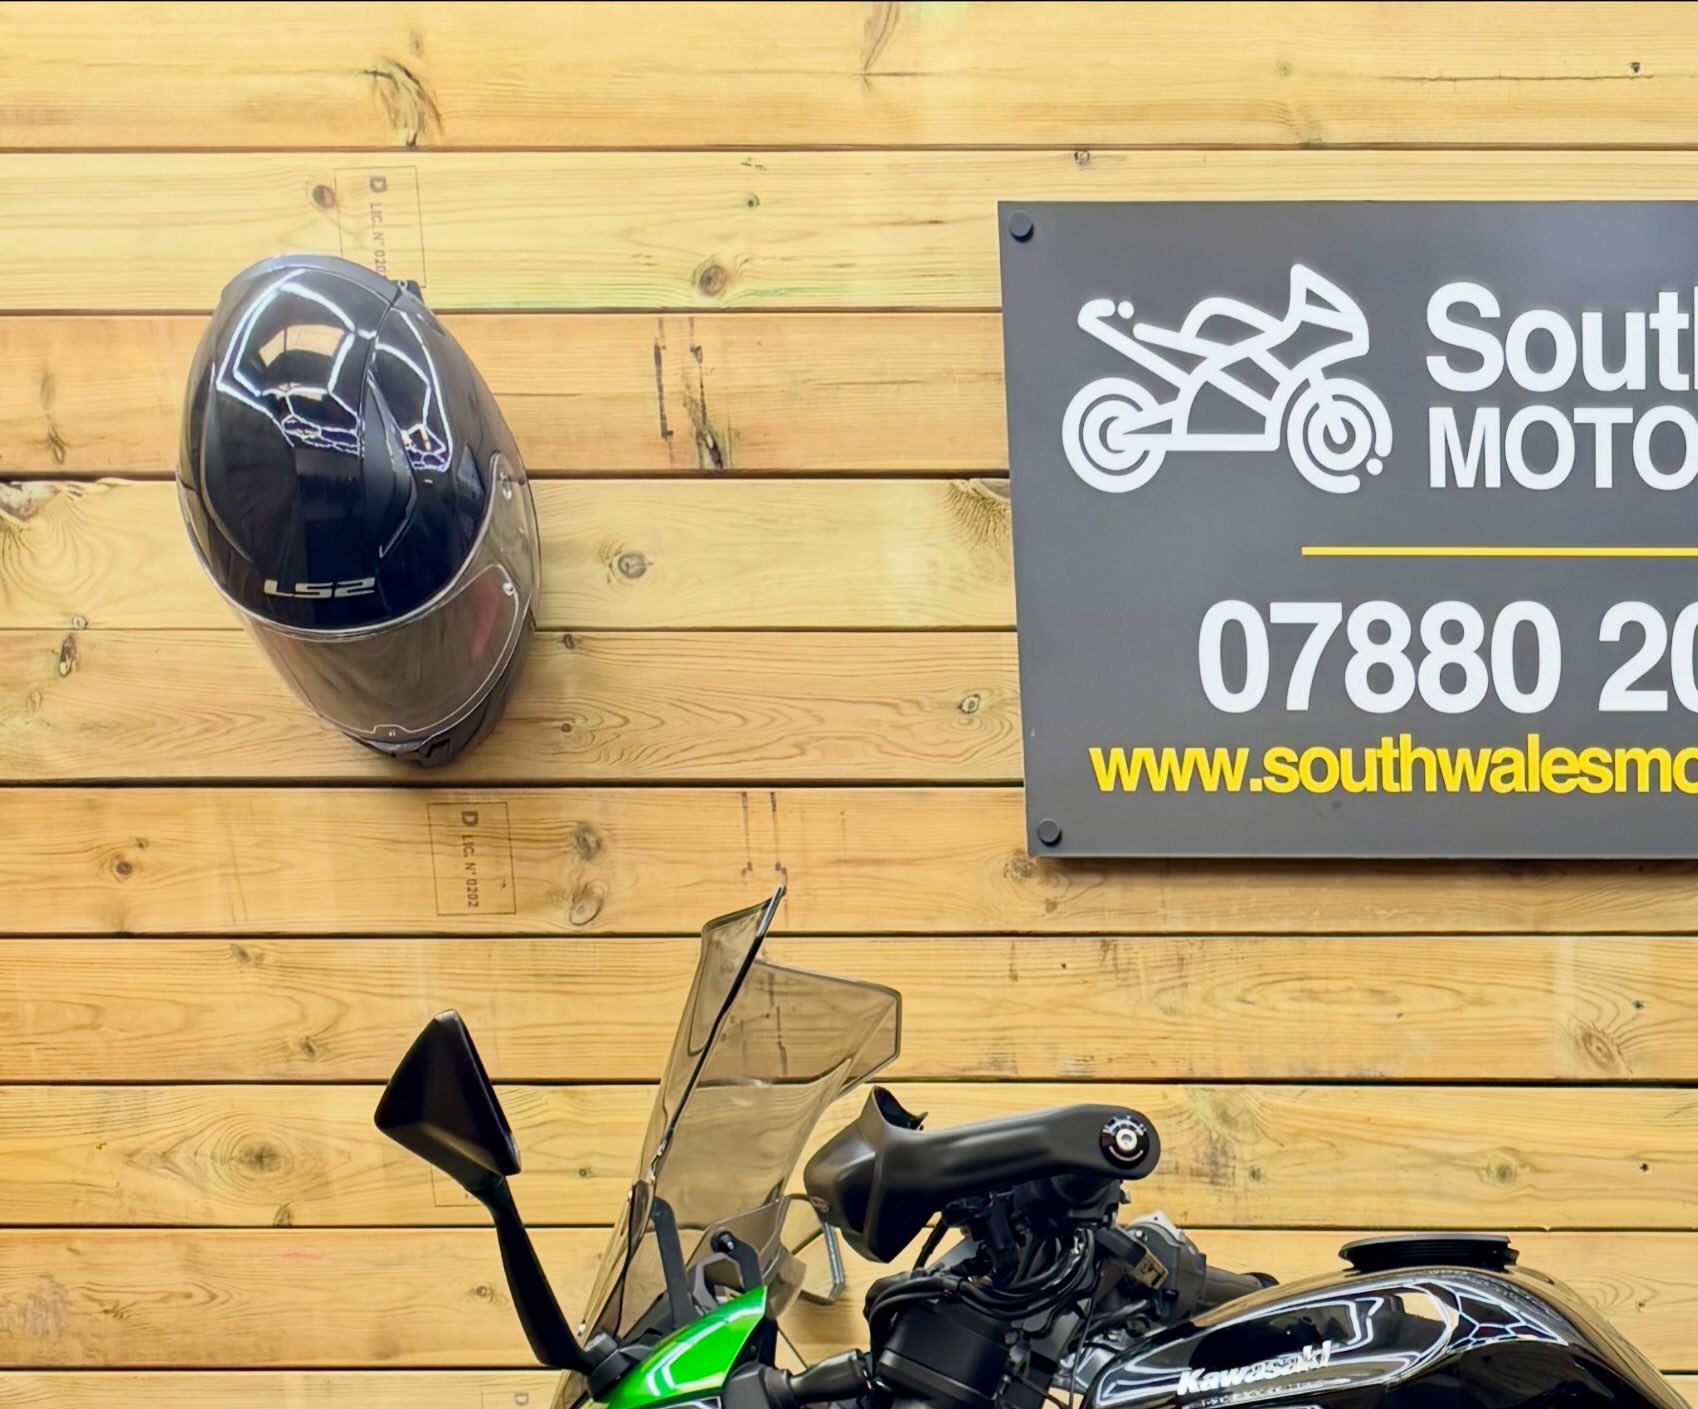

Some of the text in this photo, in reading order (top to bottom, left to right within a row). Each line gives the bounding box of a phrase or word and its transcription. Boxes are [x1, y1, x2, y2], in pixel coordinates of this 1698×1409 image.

[369, 176, 388, 193] D
[374, 249, 388, 277] 020
[263, 576, 376, 599] LS2
[1197, 598, 1563, 715] 07880
[461, 811, 479, 827] D
[466, 879, 479, 908] 0202
[1177, 1340, 1333, 1397] Kawasaki
[514, 1392, 530, 1407] D
